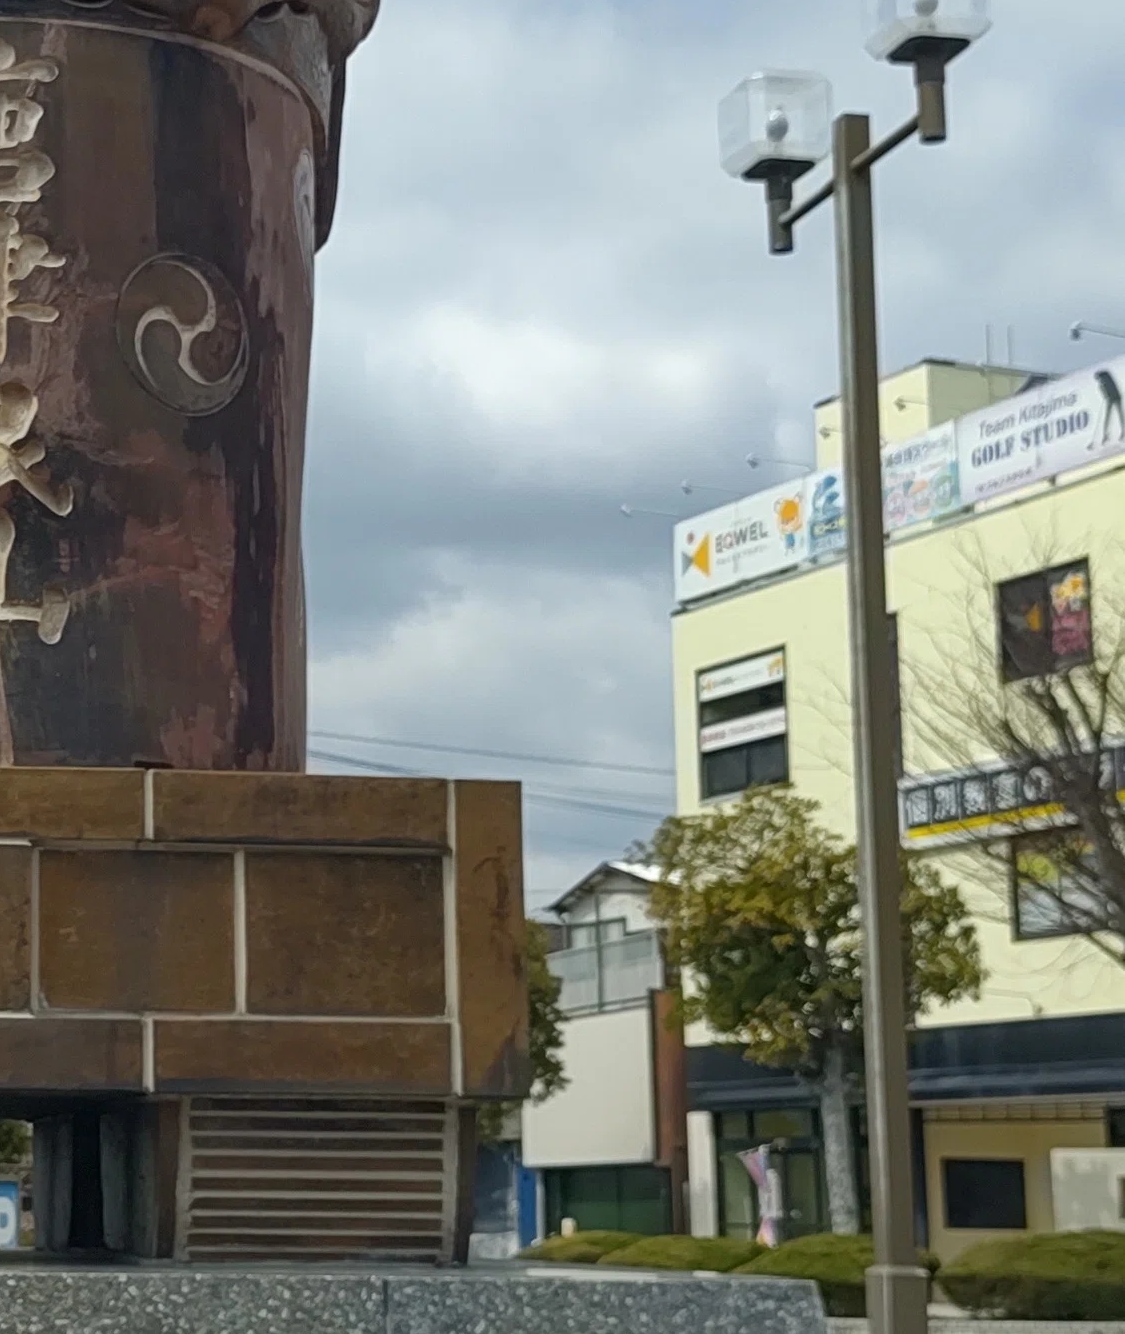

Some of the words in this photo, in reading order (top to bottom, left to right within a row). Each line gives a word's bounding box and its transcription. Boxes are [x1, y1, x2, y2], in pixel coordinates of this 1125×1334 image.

[978, 414, 1016, 439] Team
[1018, 391, 1078, 424] Kitajima
[970, 433, 1016, 469] GOLF
[1020, 410, 1090, 453] STUDIO
[715, 521, 769, 554] EQWEL
